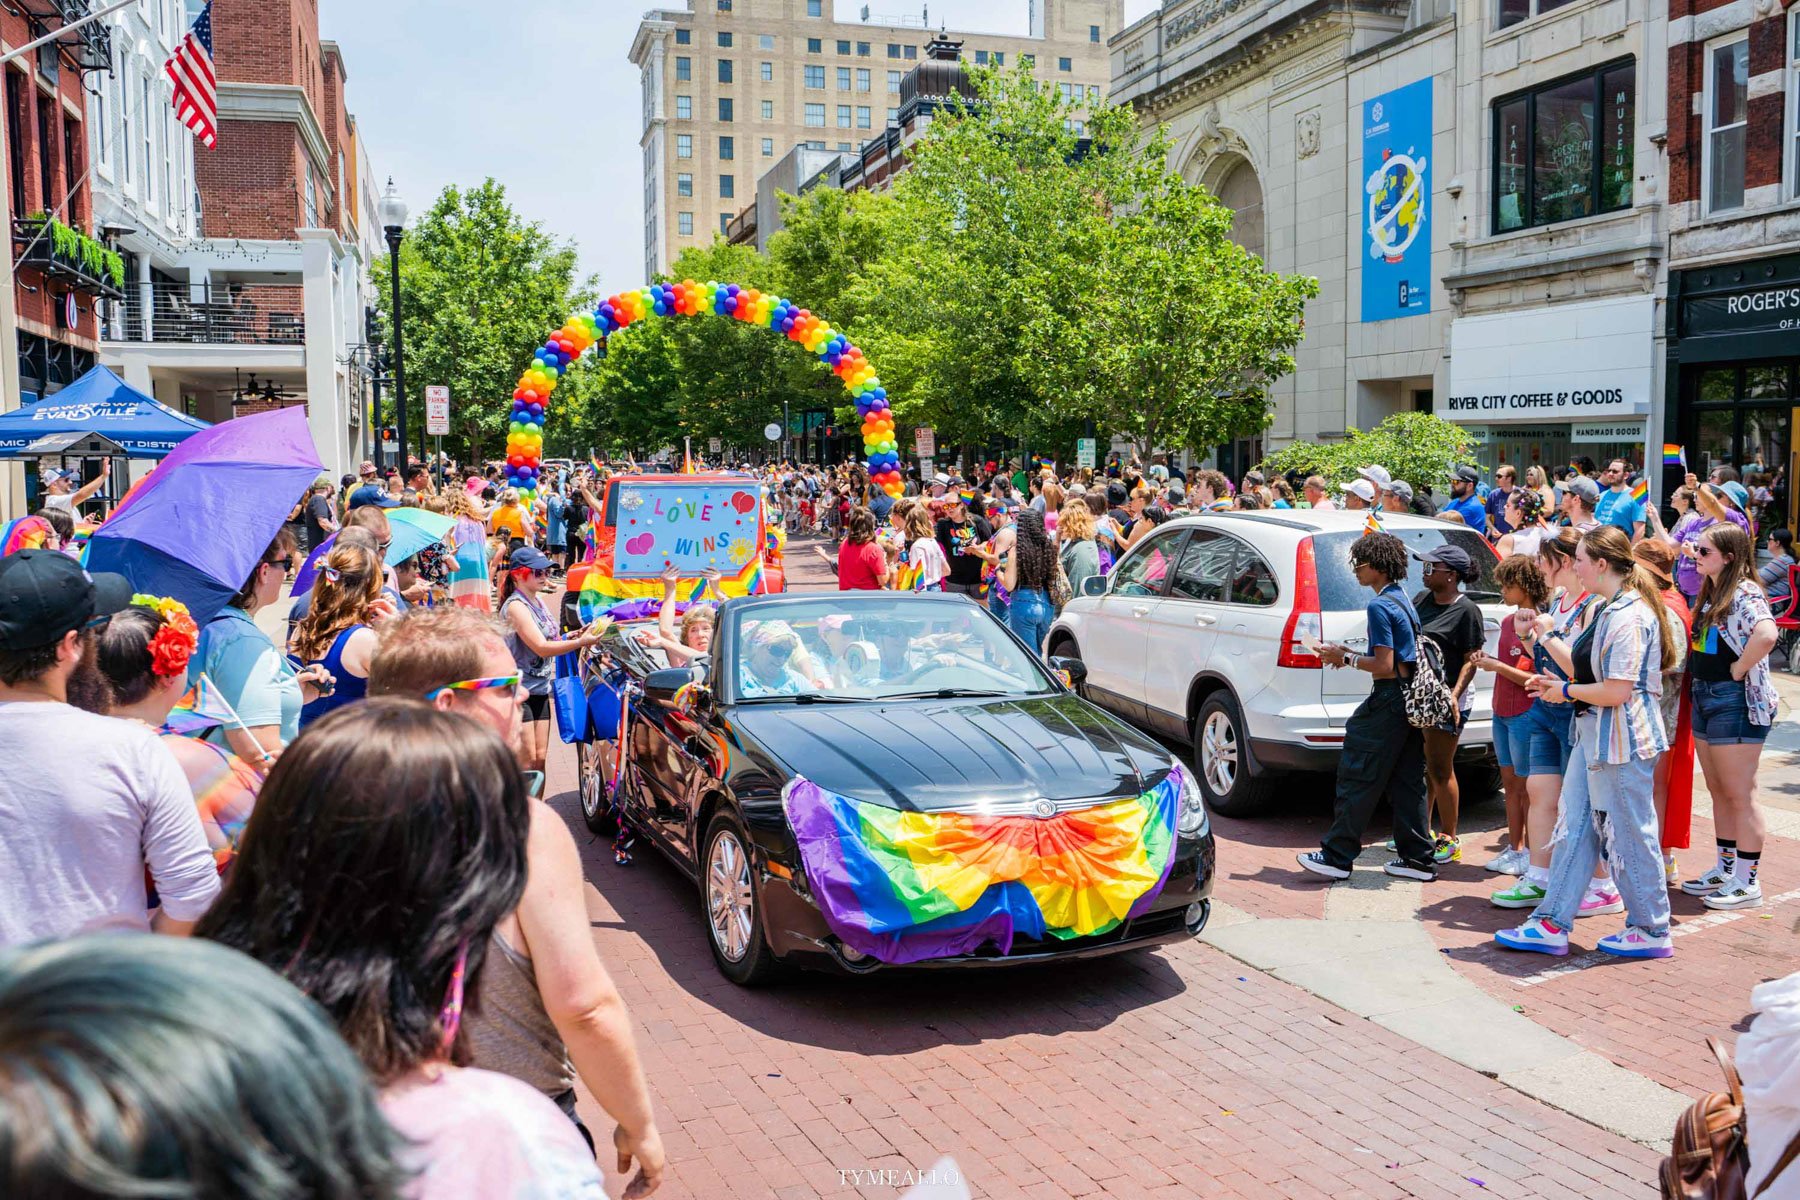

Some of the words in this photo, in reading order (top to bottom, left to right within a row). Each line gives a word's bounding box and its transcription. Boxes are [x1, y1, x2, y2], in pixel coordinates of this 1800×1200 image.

[1615, 91, 1626, 182] MUSEUM
[1400, 285, 1407, 303] e
[1728, 288, 1800, 314] ROGER'S
[1779, 319, 1793, 329] OF
[37, 402, 140, 413] DOWNTOWN
[1448, 397, 1479, 410] RIVER
[1481, 395, 1506, 409] CITY
[1510, 393, 1553, 409] COFFEE
[1556, 392, 1569, 406] &
[1572, 388, 1623, 405] GOODS
[32, 406, 138, 421] EVANSVILLE
[1576, 428, 1614, 437] HANDMADE
[1616, 427, 1641, 436] GOODS
[138, 441, 181, 449] DISTR
[654, 498, 713, 523] LOVE
[675, 532, 730, 557] WINS
